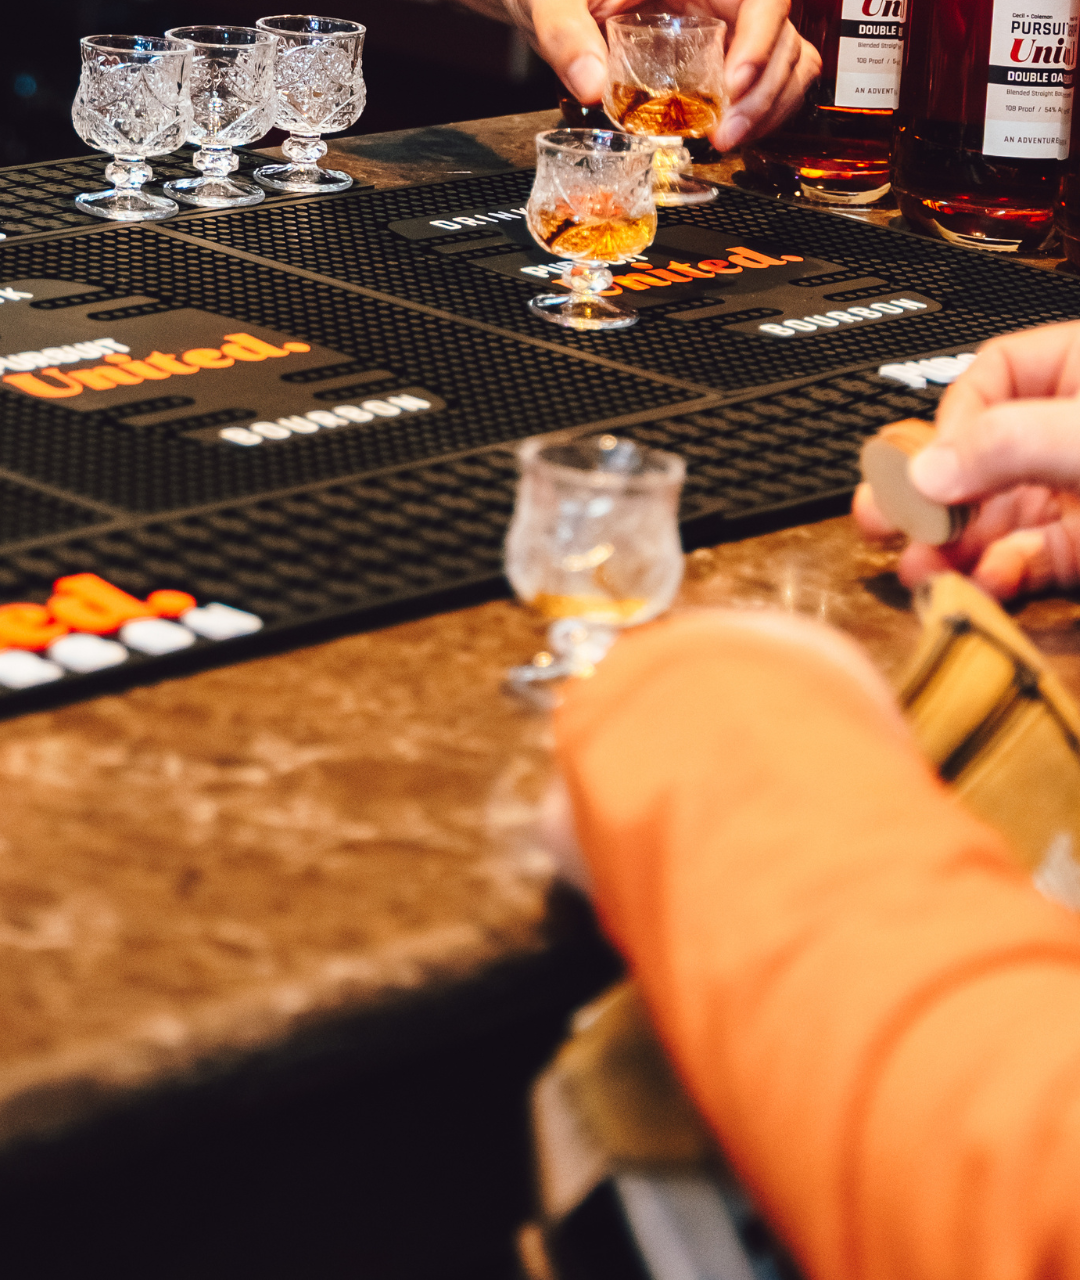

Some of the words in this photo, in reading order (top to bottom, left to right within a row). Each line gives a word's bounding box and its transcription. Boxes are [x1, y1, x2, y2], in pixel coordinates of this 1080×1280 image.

[858, 24, 897, 36] DOUBLE
[868, 57, 884, 65] Proof
[1007, 70, 1049, 83] DOUBLE
[1006, 88, 1030, 96] Blended
[1017, 105, 1035, 113] Proof
[1003, 135, 1015, 143] AN
[758, 298, 927, 337] BOURBON
[219, 393, 431, 446] BOURBON
